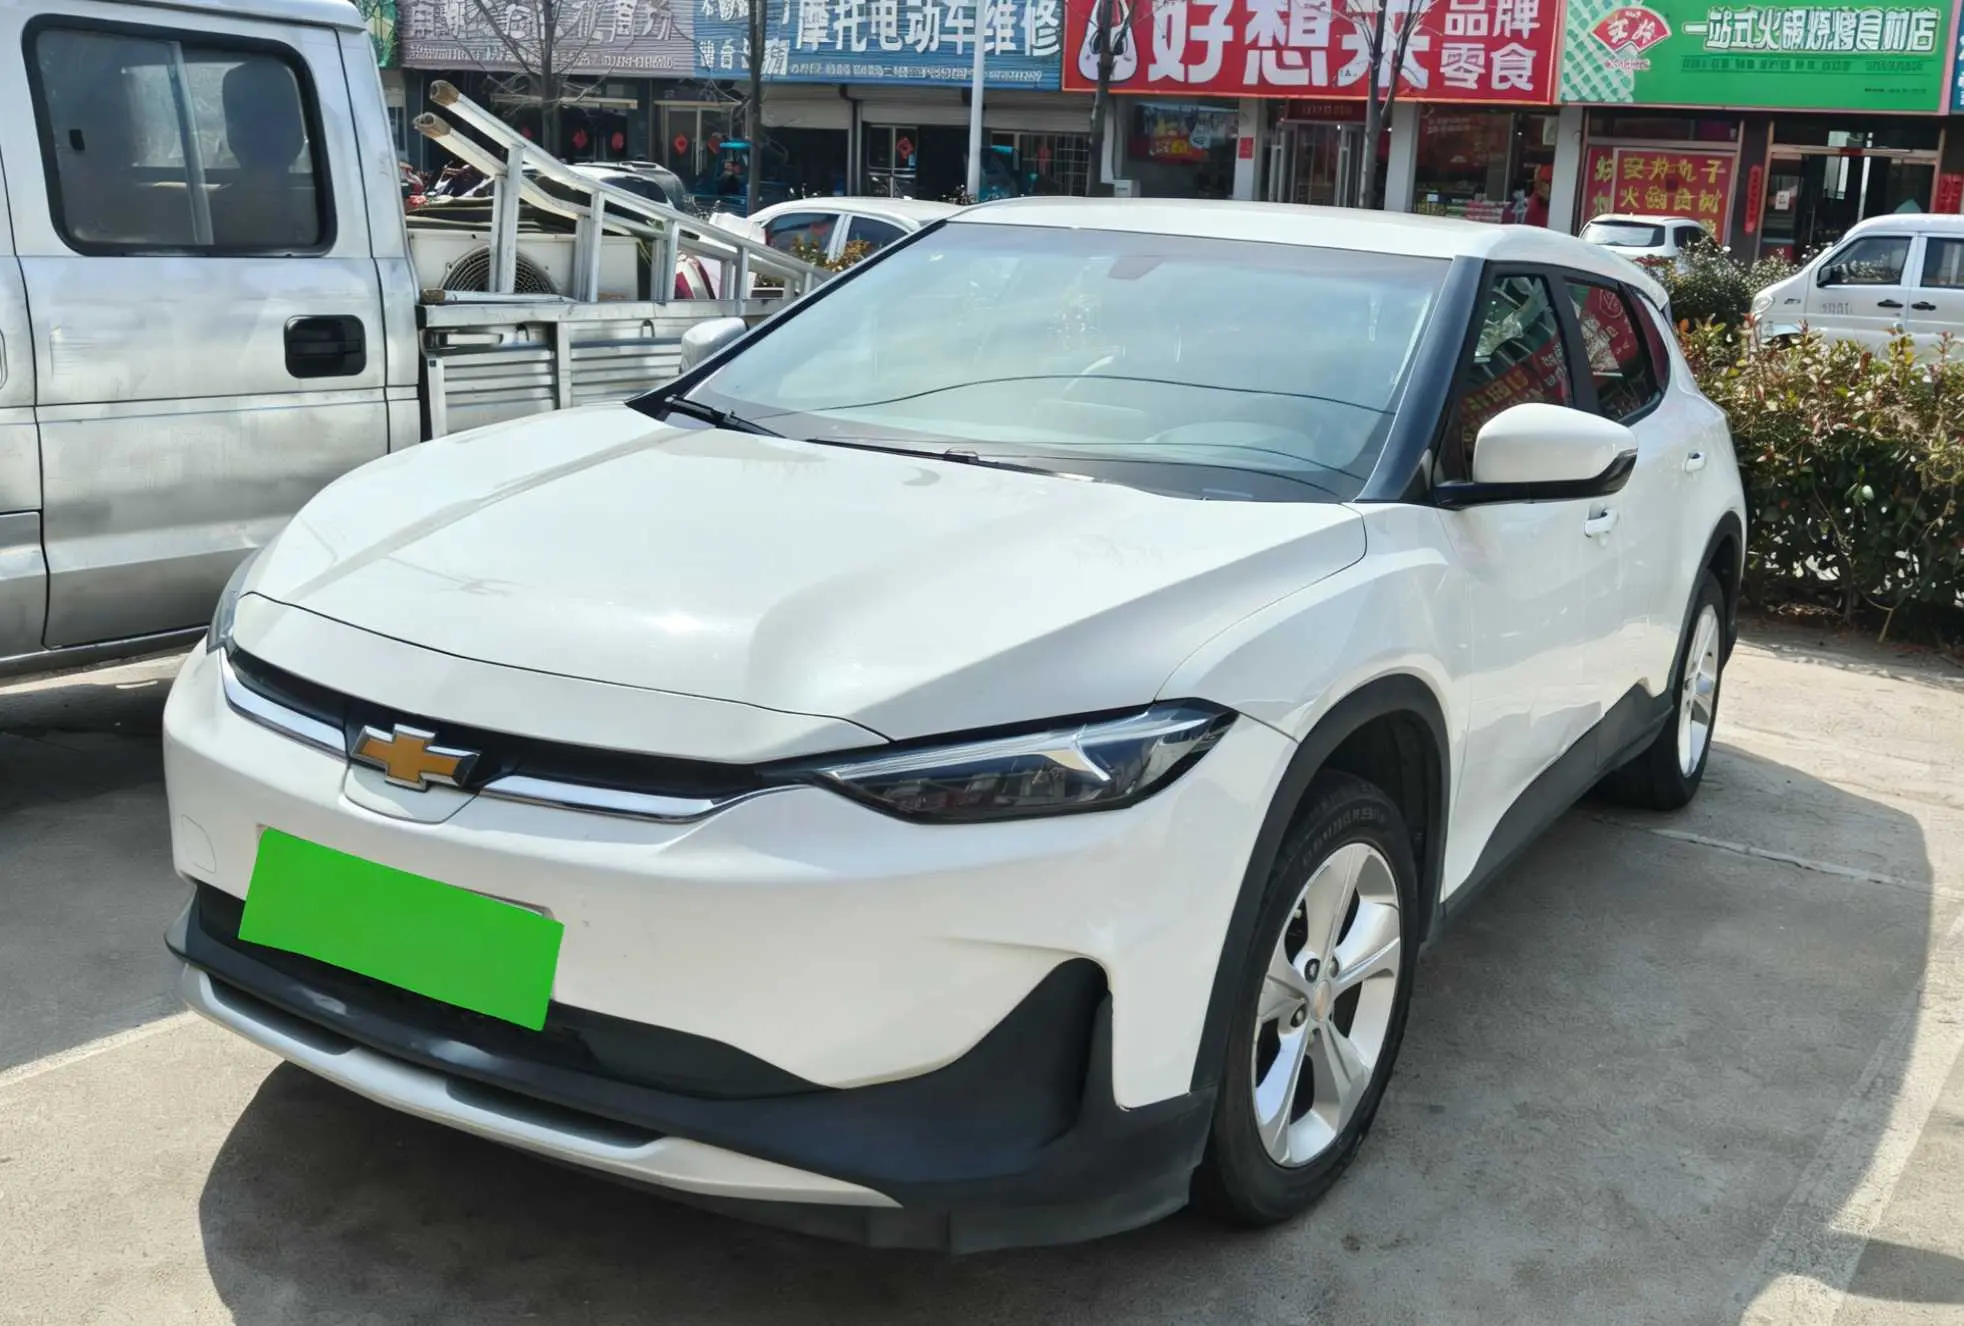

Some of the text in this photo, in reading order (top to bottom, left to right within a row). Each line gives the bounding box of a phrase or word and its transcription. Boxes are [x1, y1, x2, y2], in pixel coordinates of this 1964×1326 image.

[796, 0, 1061, 57] 摩托电动车维修
[1444, 0, 1541, 39] 品牌
[1684, 6, 1939, 52] 一站式火锅烧烤食材店
[1147, 0, 1430, 89] 好想来
[1440, 42, 1537, 91] 零食
